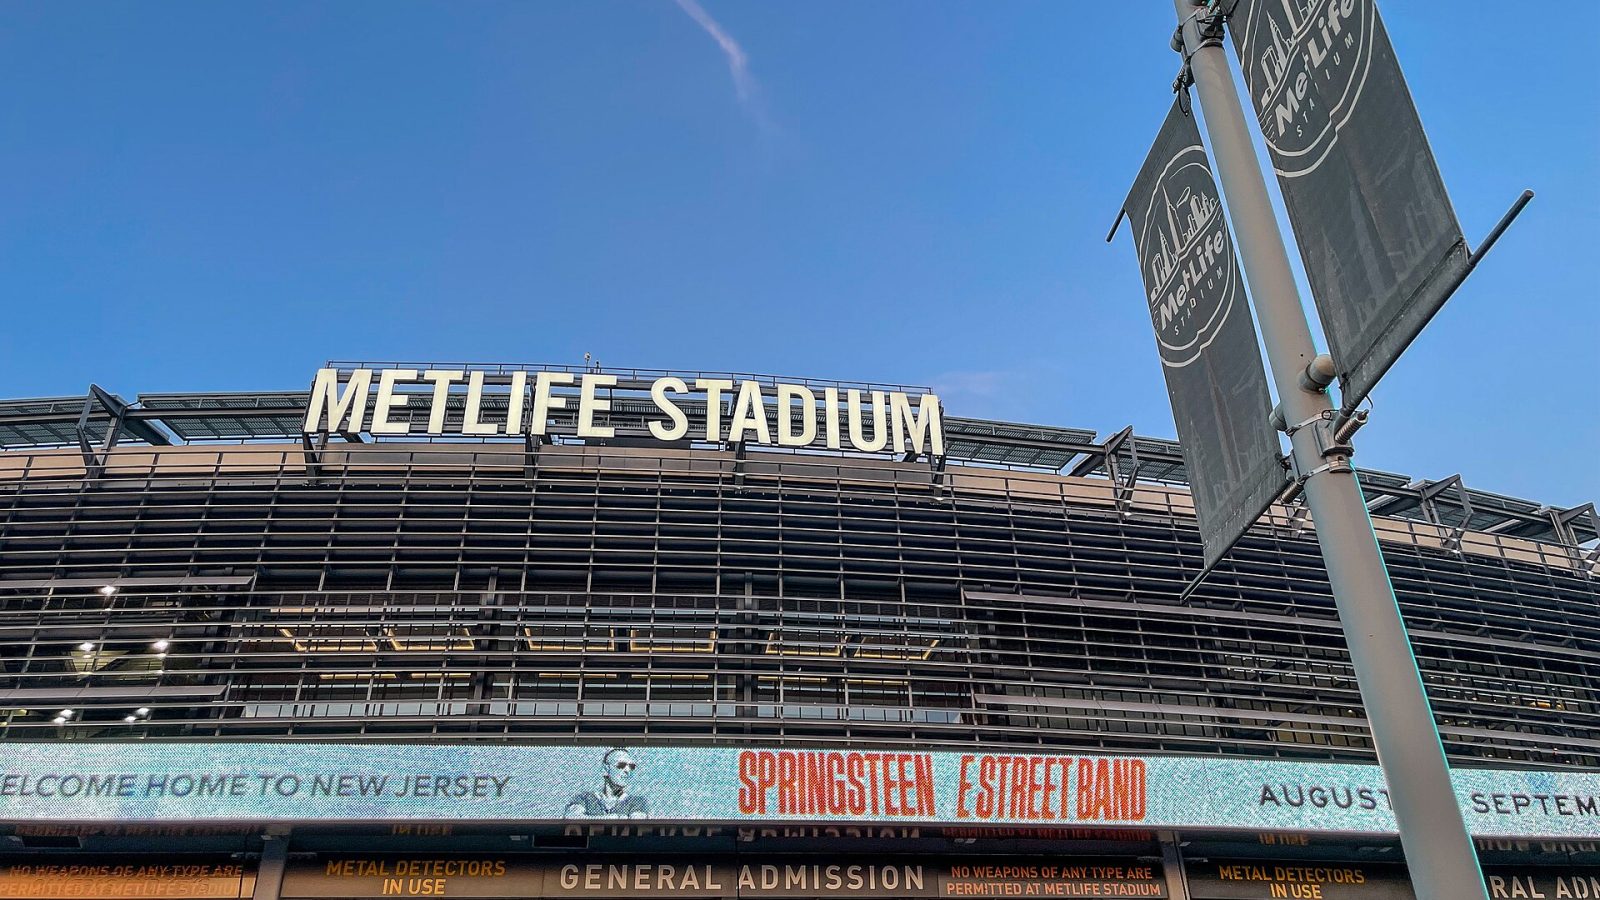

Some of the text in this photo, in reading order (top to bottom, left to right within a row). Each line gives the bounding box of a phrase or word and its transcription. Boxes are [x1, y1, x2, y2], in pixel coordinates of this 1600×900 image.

[1296, 32, 1354, 138] STAIUM
[1160, 230, 1224, 331] MetLife
[1174, 266, 1223, 336] STADIUM
[303, 368, 945, 456] METLIFE STADIUM
[0, 773, 510, 798] ELCOME HOME TO NEW JERSEY
[738, 750, 935, 816] SPRINGSTEEN
[956, 754, 1147, 822] E STREET BAND
[326, 860, 506, 877] METAL DETECTORS
[560, 864, 924, 890] GENERAL ADMISSION
[951, 866, 1153, 880] NO WEAPONS OF ANY TYPE ARE
[1219, 865, 1365, 883] METAL DETECTORS
[382, 879, 446, 895] IN USE
[947, 882, 1161, 896] PERMITTED AT METLIFE STADIUM
[1270, 883, 1323, 899] IN USE
